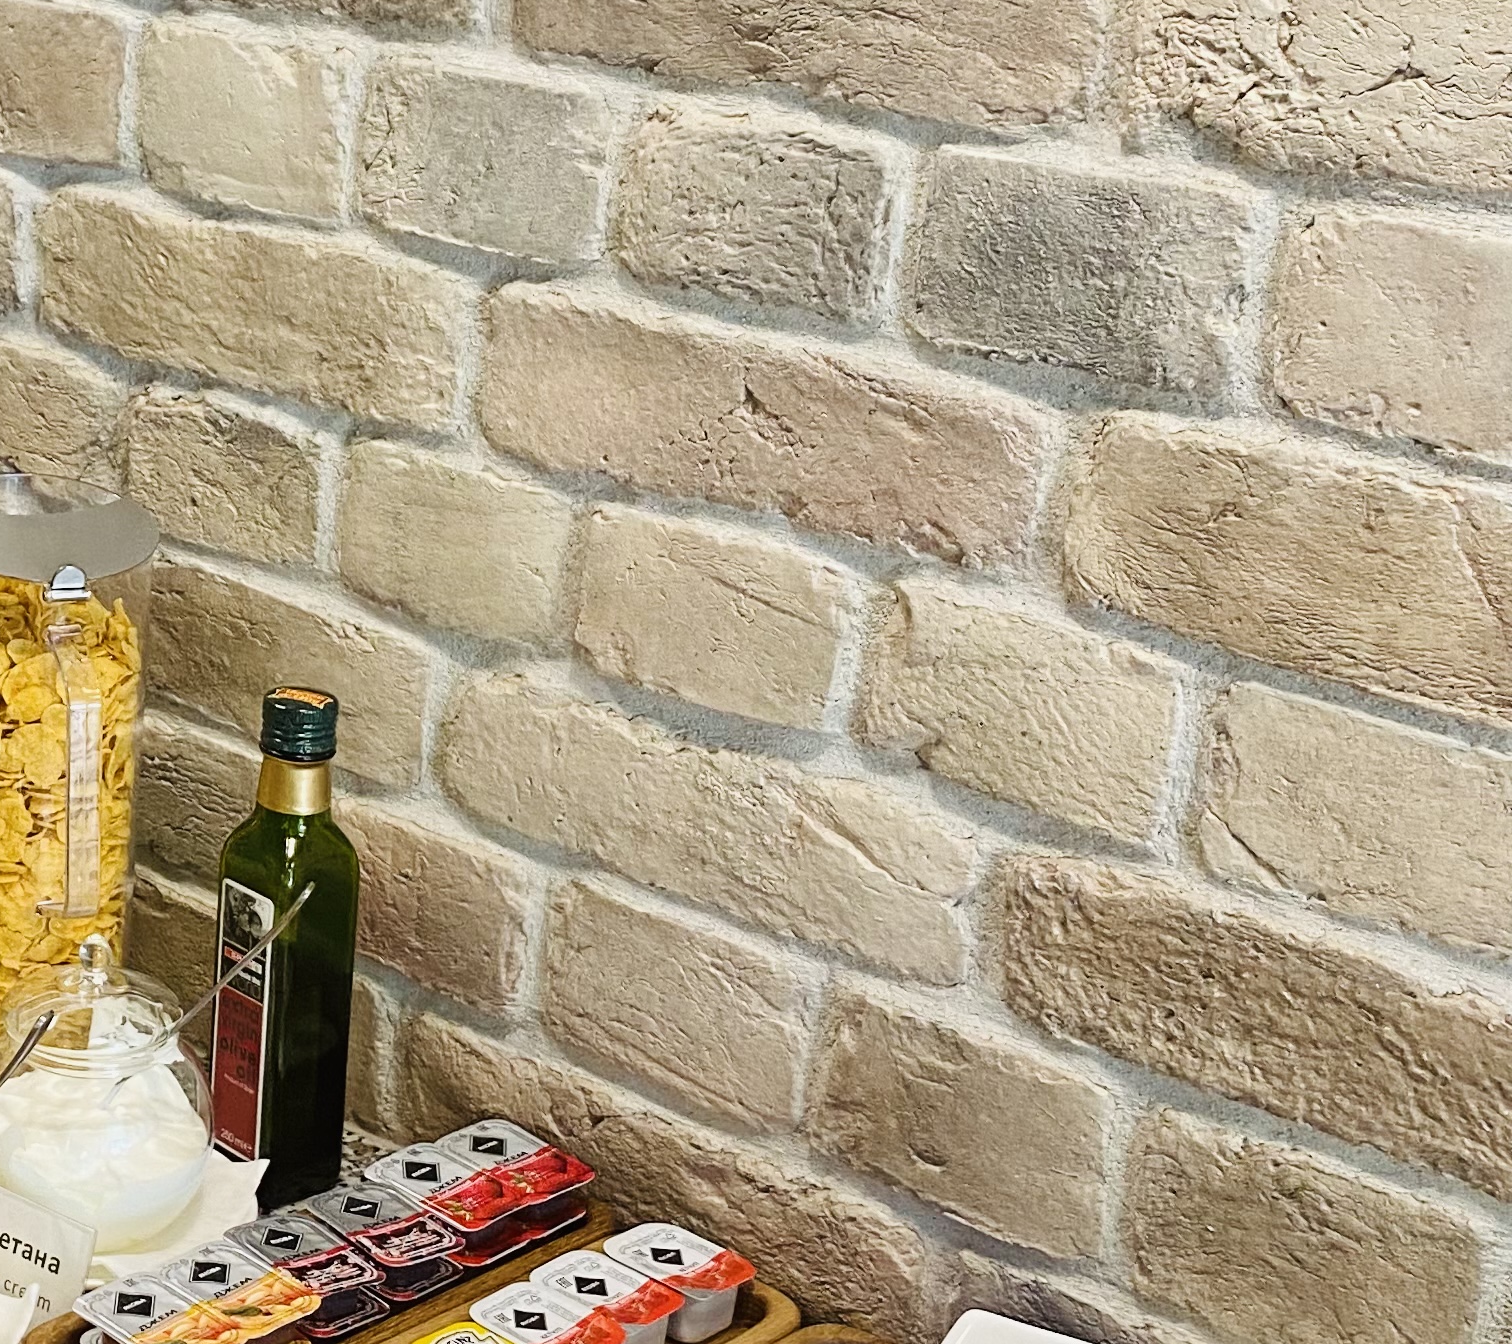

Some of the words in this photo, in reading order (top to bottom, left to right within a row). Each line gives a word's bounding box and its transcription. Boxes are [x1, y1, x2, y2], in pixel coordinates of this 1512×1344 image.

[428, 1175, 463, 1194] ДЖЕМ
[3, 1278, 51, 1313] crem
[213, 1277, 253, 1299] ДЖЕМ
[139, 1309, 178, 1332] ДЖЕМ
